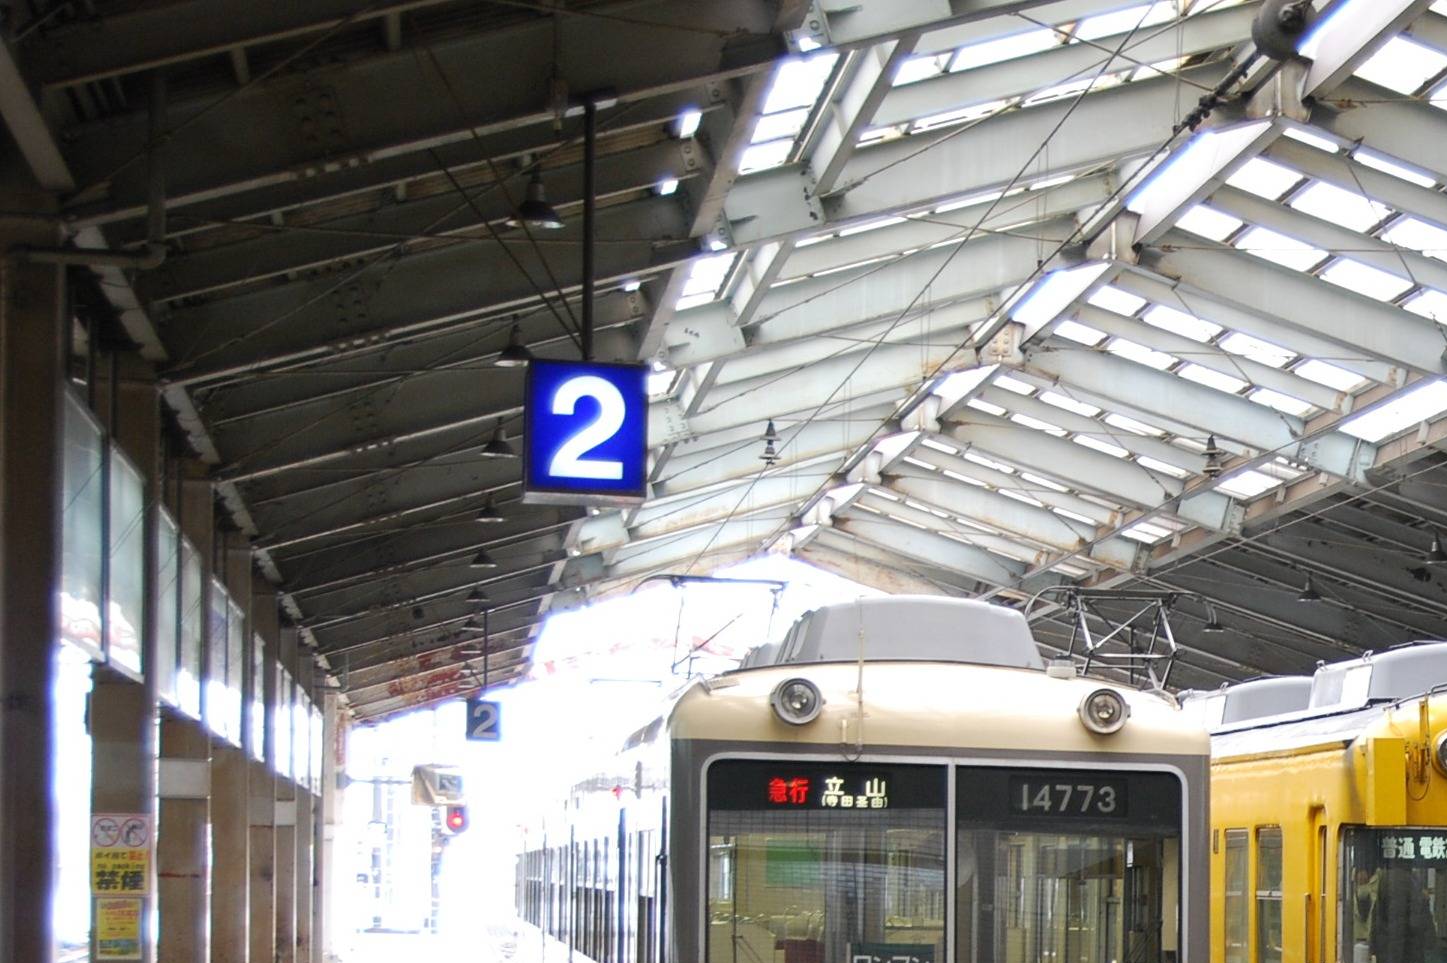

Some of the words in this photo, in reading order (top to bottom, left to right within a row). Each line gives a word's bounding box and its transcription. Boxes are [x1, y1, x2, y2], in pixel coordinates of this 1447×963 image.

[549, 375, 626, 480] 2
[473, 704, 497, 738] 2
[769, 778, 809, 804] 急行
[824, 776, 886, 798] 立山
[1022, 784, 1116, 812] 14773
[1382, 836, 1416, 859] 普通
